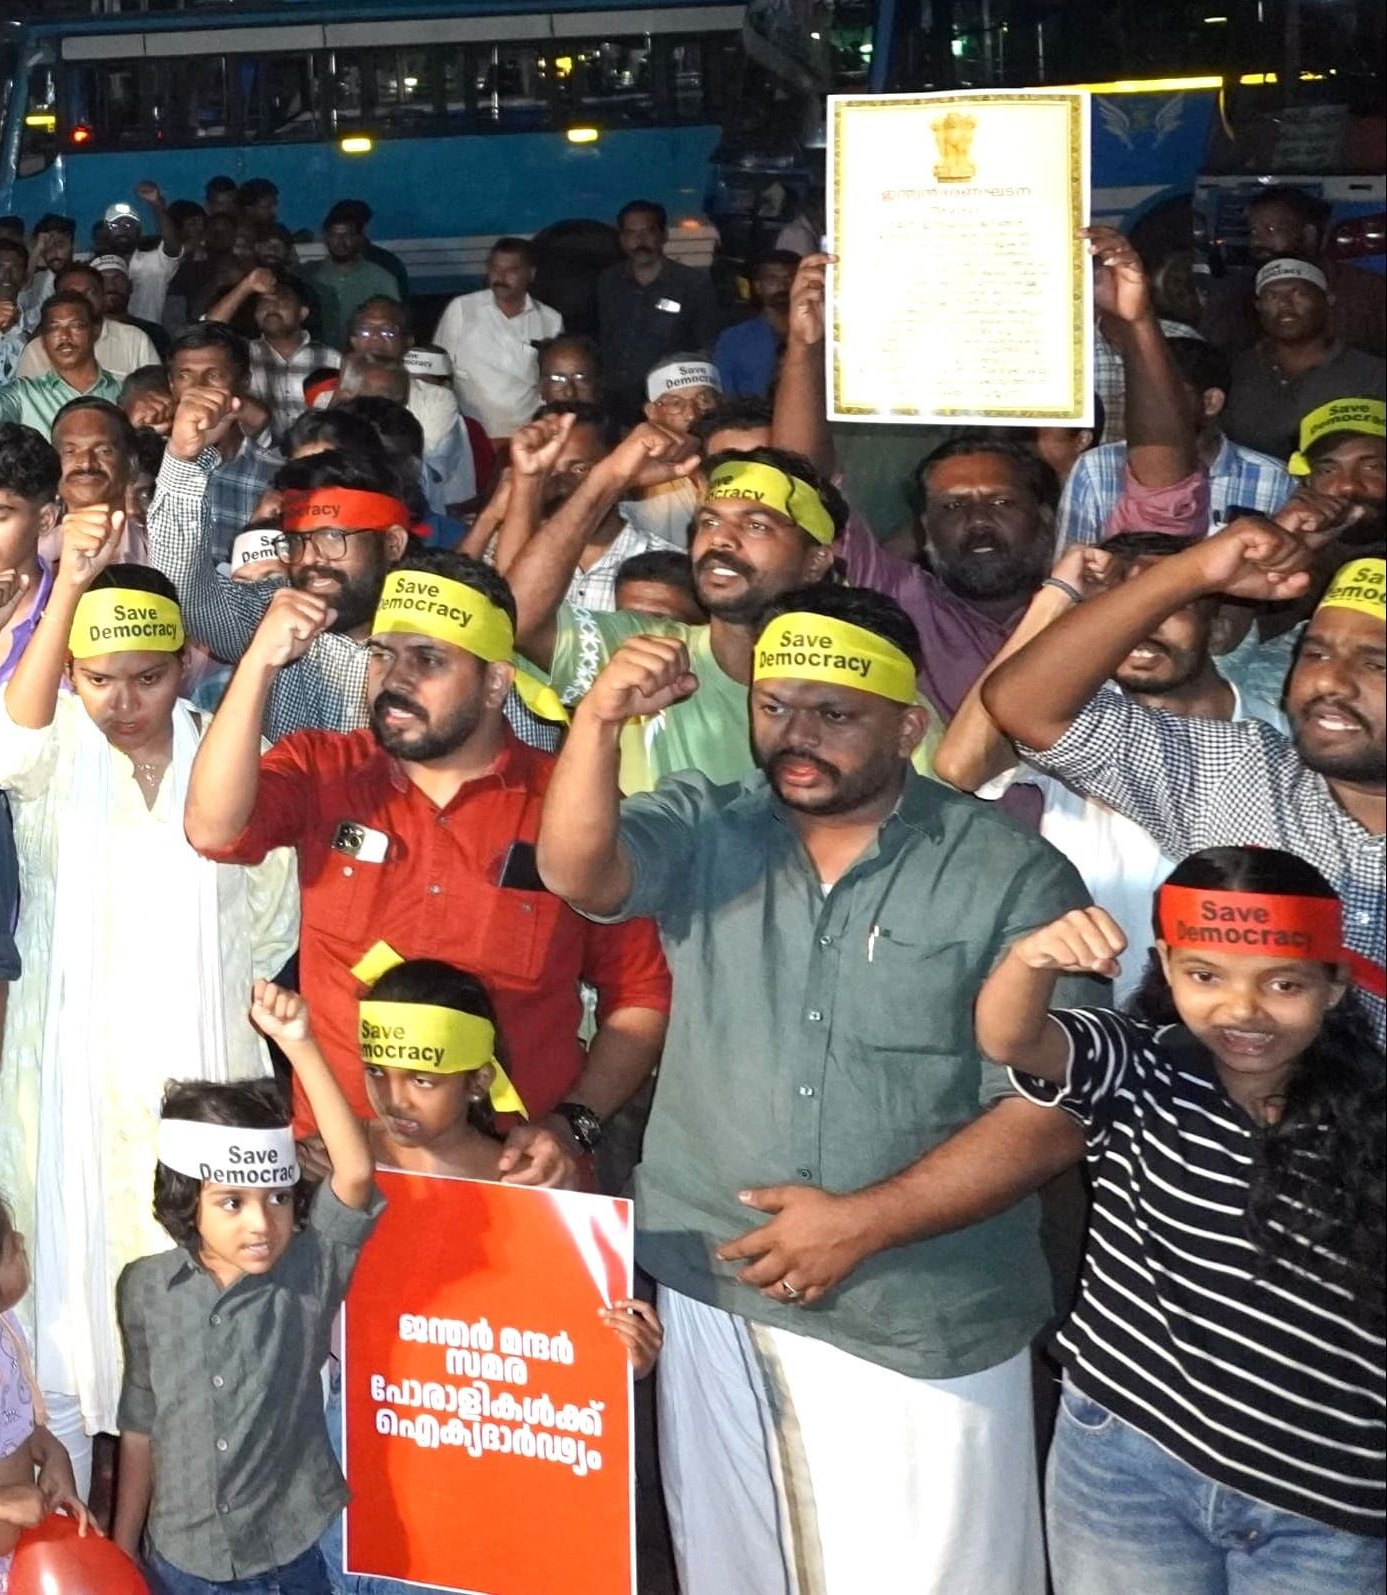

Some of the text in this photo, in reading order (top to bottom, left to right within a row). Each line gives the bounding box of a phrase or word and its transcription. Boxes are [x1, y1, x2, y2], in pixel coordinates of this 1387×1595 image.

[679, 366, 707, 375] Save
[1329, 404, 1371, 415] Save
[395, 578, 440, 597] Save
[1352, 568, 1385, 585] Sa
[114, 605, 158, 621] Save
[90, 621, 178, 643] Democracy
[780, 630, 832, 649] Save
[759, 650, 872, 677] Democracy
[1201, 900, 1269, 925] Save
[1176, 920, 1313, 951] Democracy
[361, 1018, 405, 1040] Save
[362, 1041, 445, 1067] mocracy
[228, 1145, 278, 1164] Save
[199, 1162, 295, 1185] Democrac
[398, 1313, 575, 1365] ജന്തർ മന്ദർ
[445, 1347, 528, 1385] സമര
[370, 1374, 606, 1437] പോരാളികൾക്ക്
